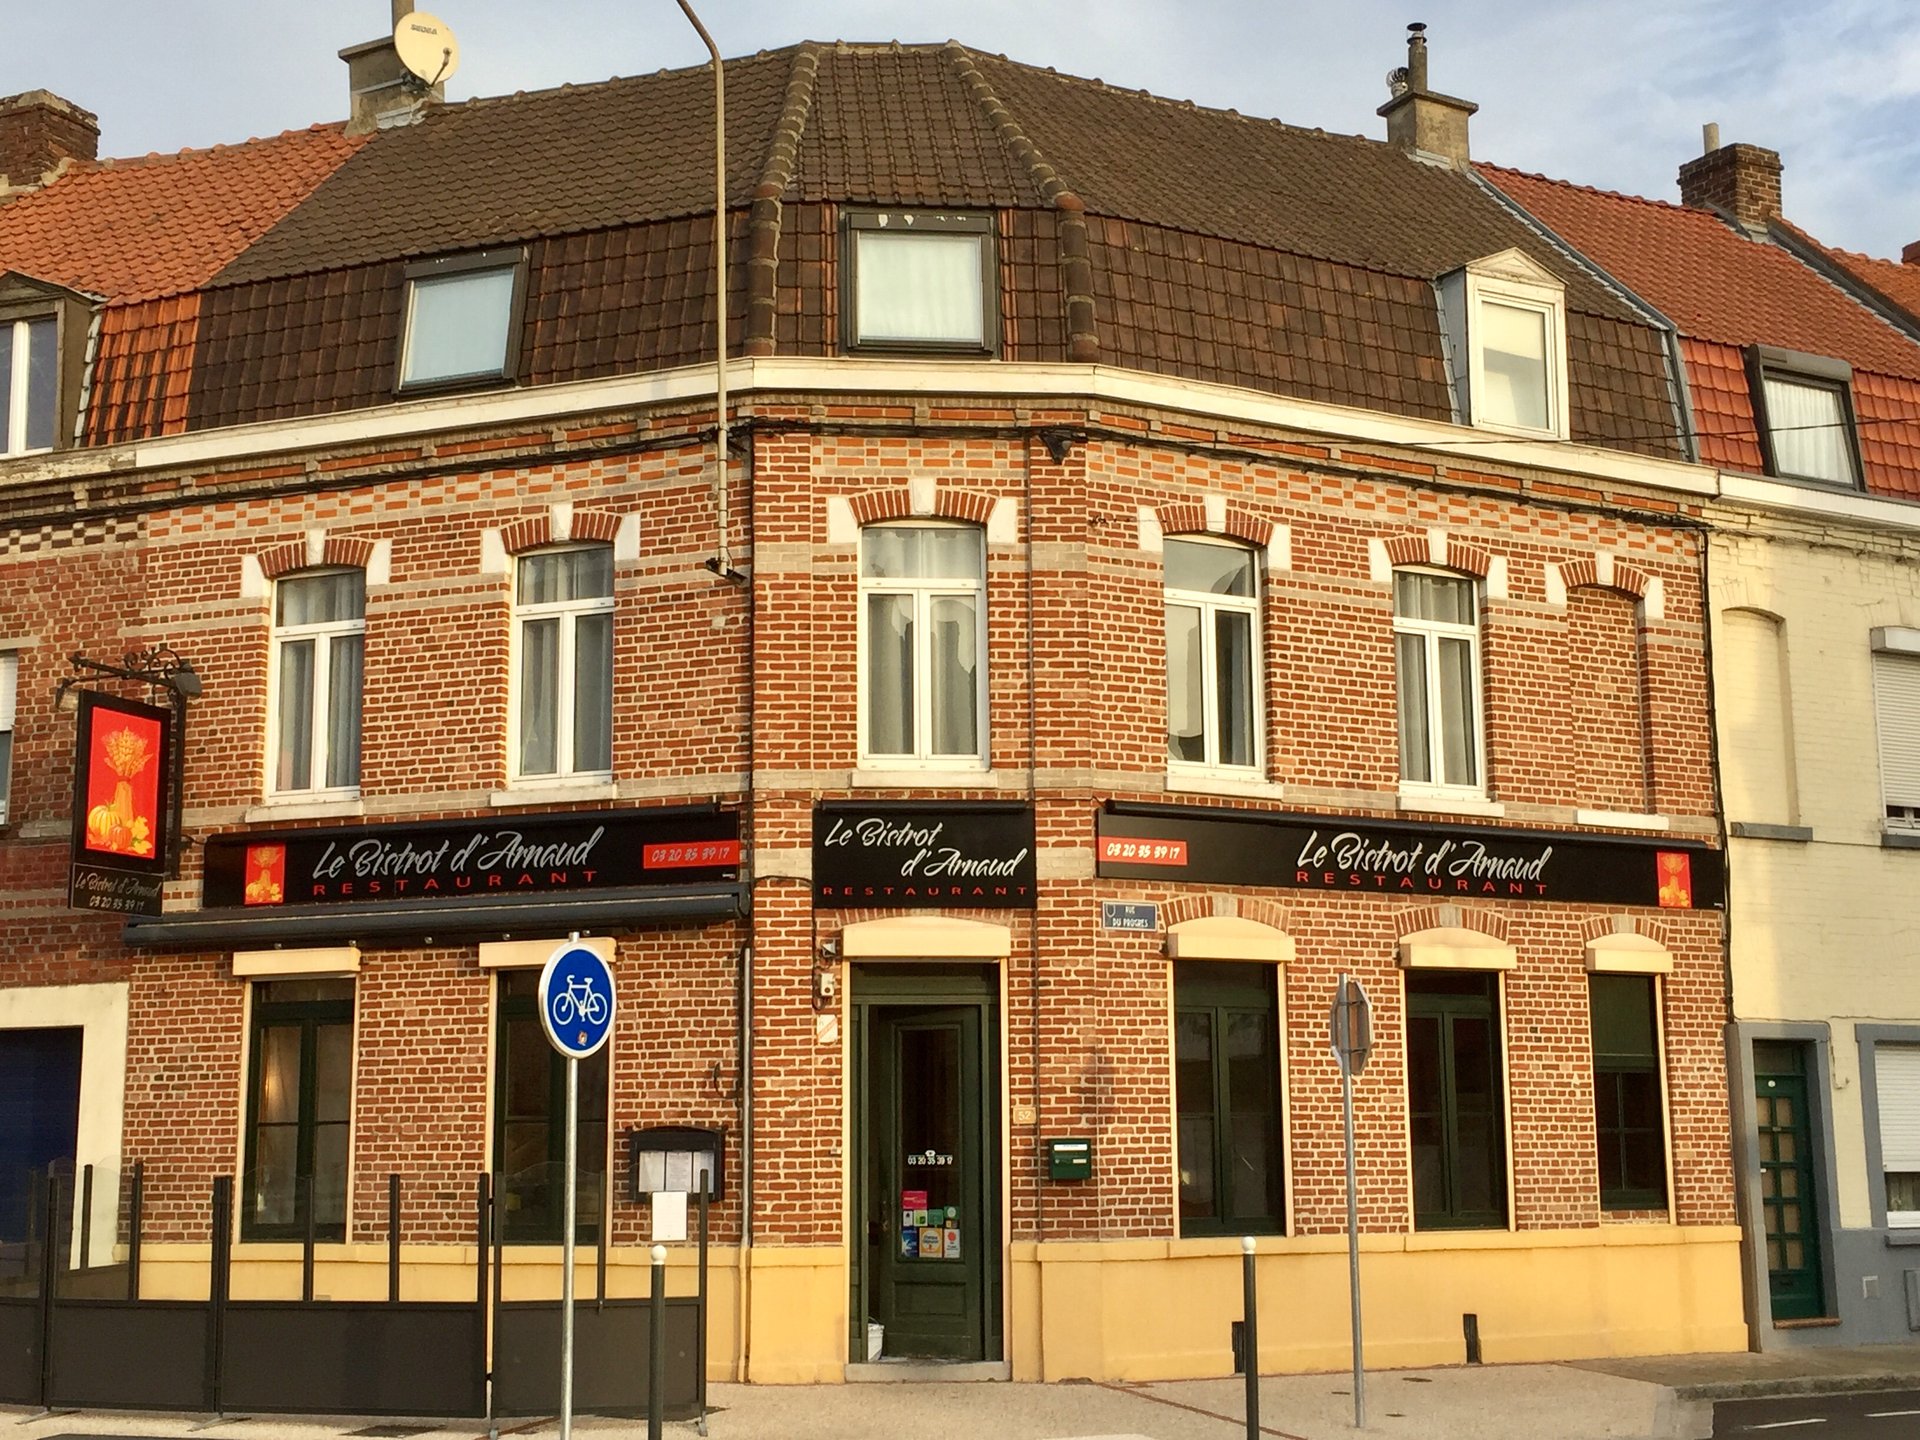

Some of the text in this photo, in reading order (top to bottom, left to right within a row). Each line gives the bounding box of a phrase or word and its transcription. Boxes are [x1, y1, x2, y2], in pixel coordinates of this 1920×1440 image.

[824, 818, 943, 846] Le Bistrot
[312, 825, 605, 879] Le Bistrot d'Arnaud
[651, 849, 667, 862] 03
[668, 848, 682, 862] 20
[719, 846, 730, 859] 17
[1106, 843, 1180, 859] 03 20 35 39 17
[1297, 830, 1553, 880] Le Bistrot d'Arnaud
[901, 848, 1028, 876] d'Arnaud
[75, 872, 86, 889] Le
[87, 873, 118, 892] Bistrot
[313, 870, 597, 896] RESTAURANT
[823, 887, 1028, 895] RESTAURANT
[1297, 871, 1547, 895] RESTAURANT
[100, 896, 112, 908] 20
[1112, 918, 1121, 926] DU
[1018, 1110, 1032, 1120] 52
